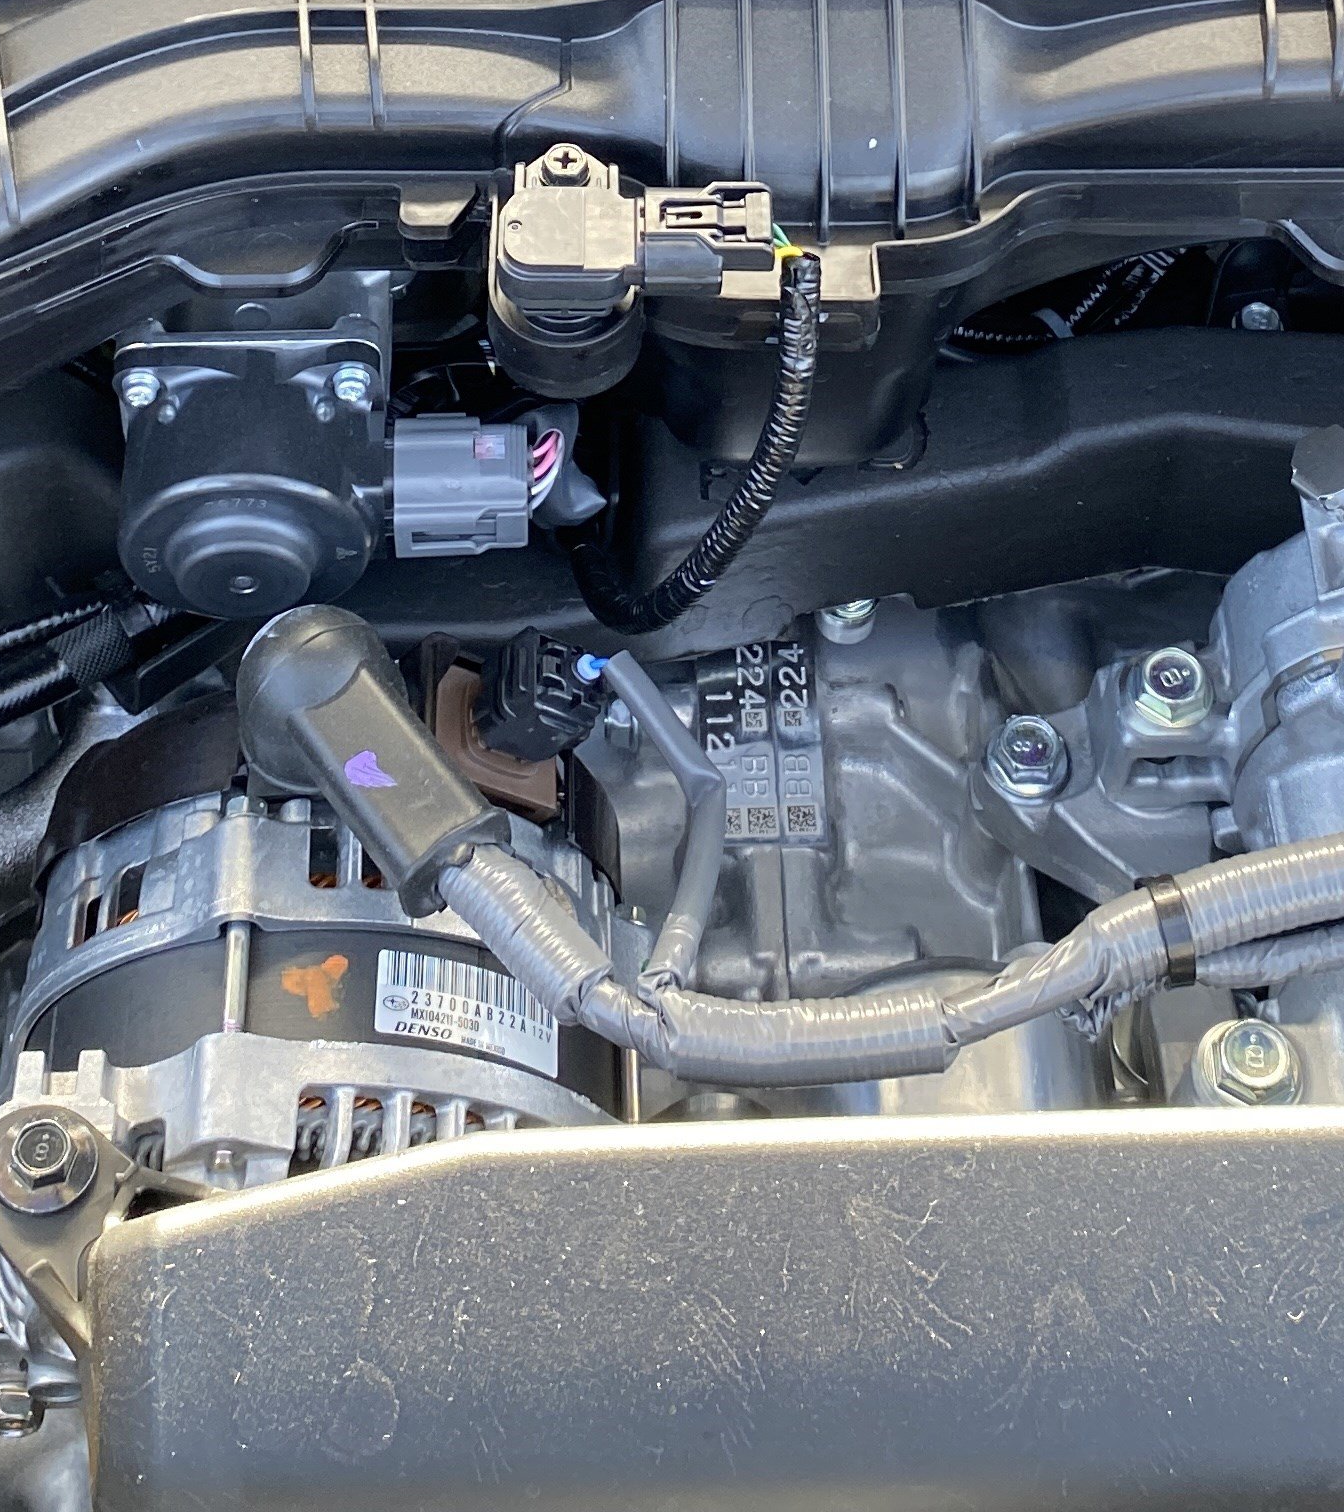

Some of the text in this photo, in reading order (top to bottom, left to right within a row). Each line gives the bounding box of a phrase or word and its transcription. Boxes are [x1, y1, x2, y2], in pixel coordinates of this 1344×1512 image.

[736, 644, 767, 710] 224
[778, 643, 809, 709] 224
[394, 1020, 453, 1040] DENSO
[411, 990, 552, 1044] 23700AB22A 12V
